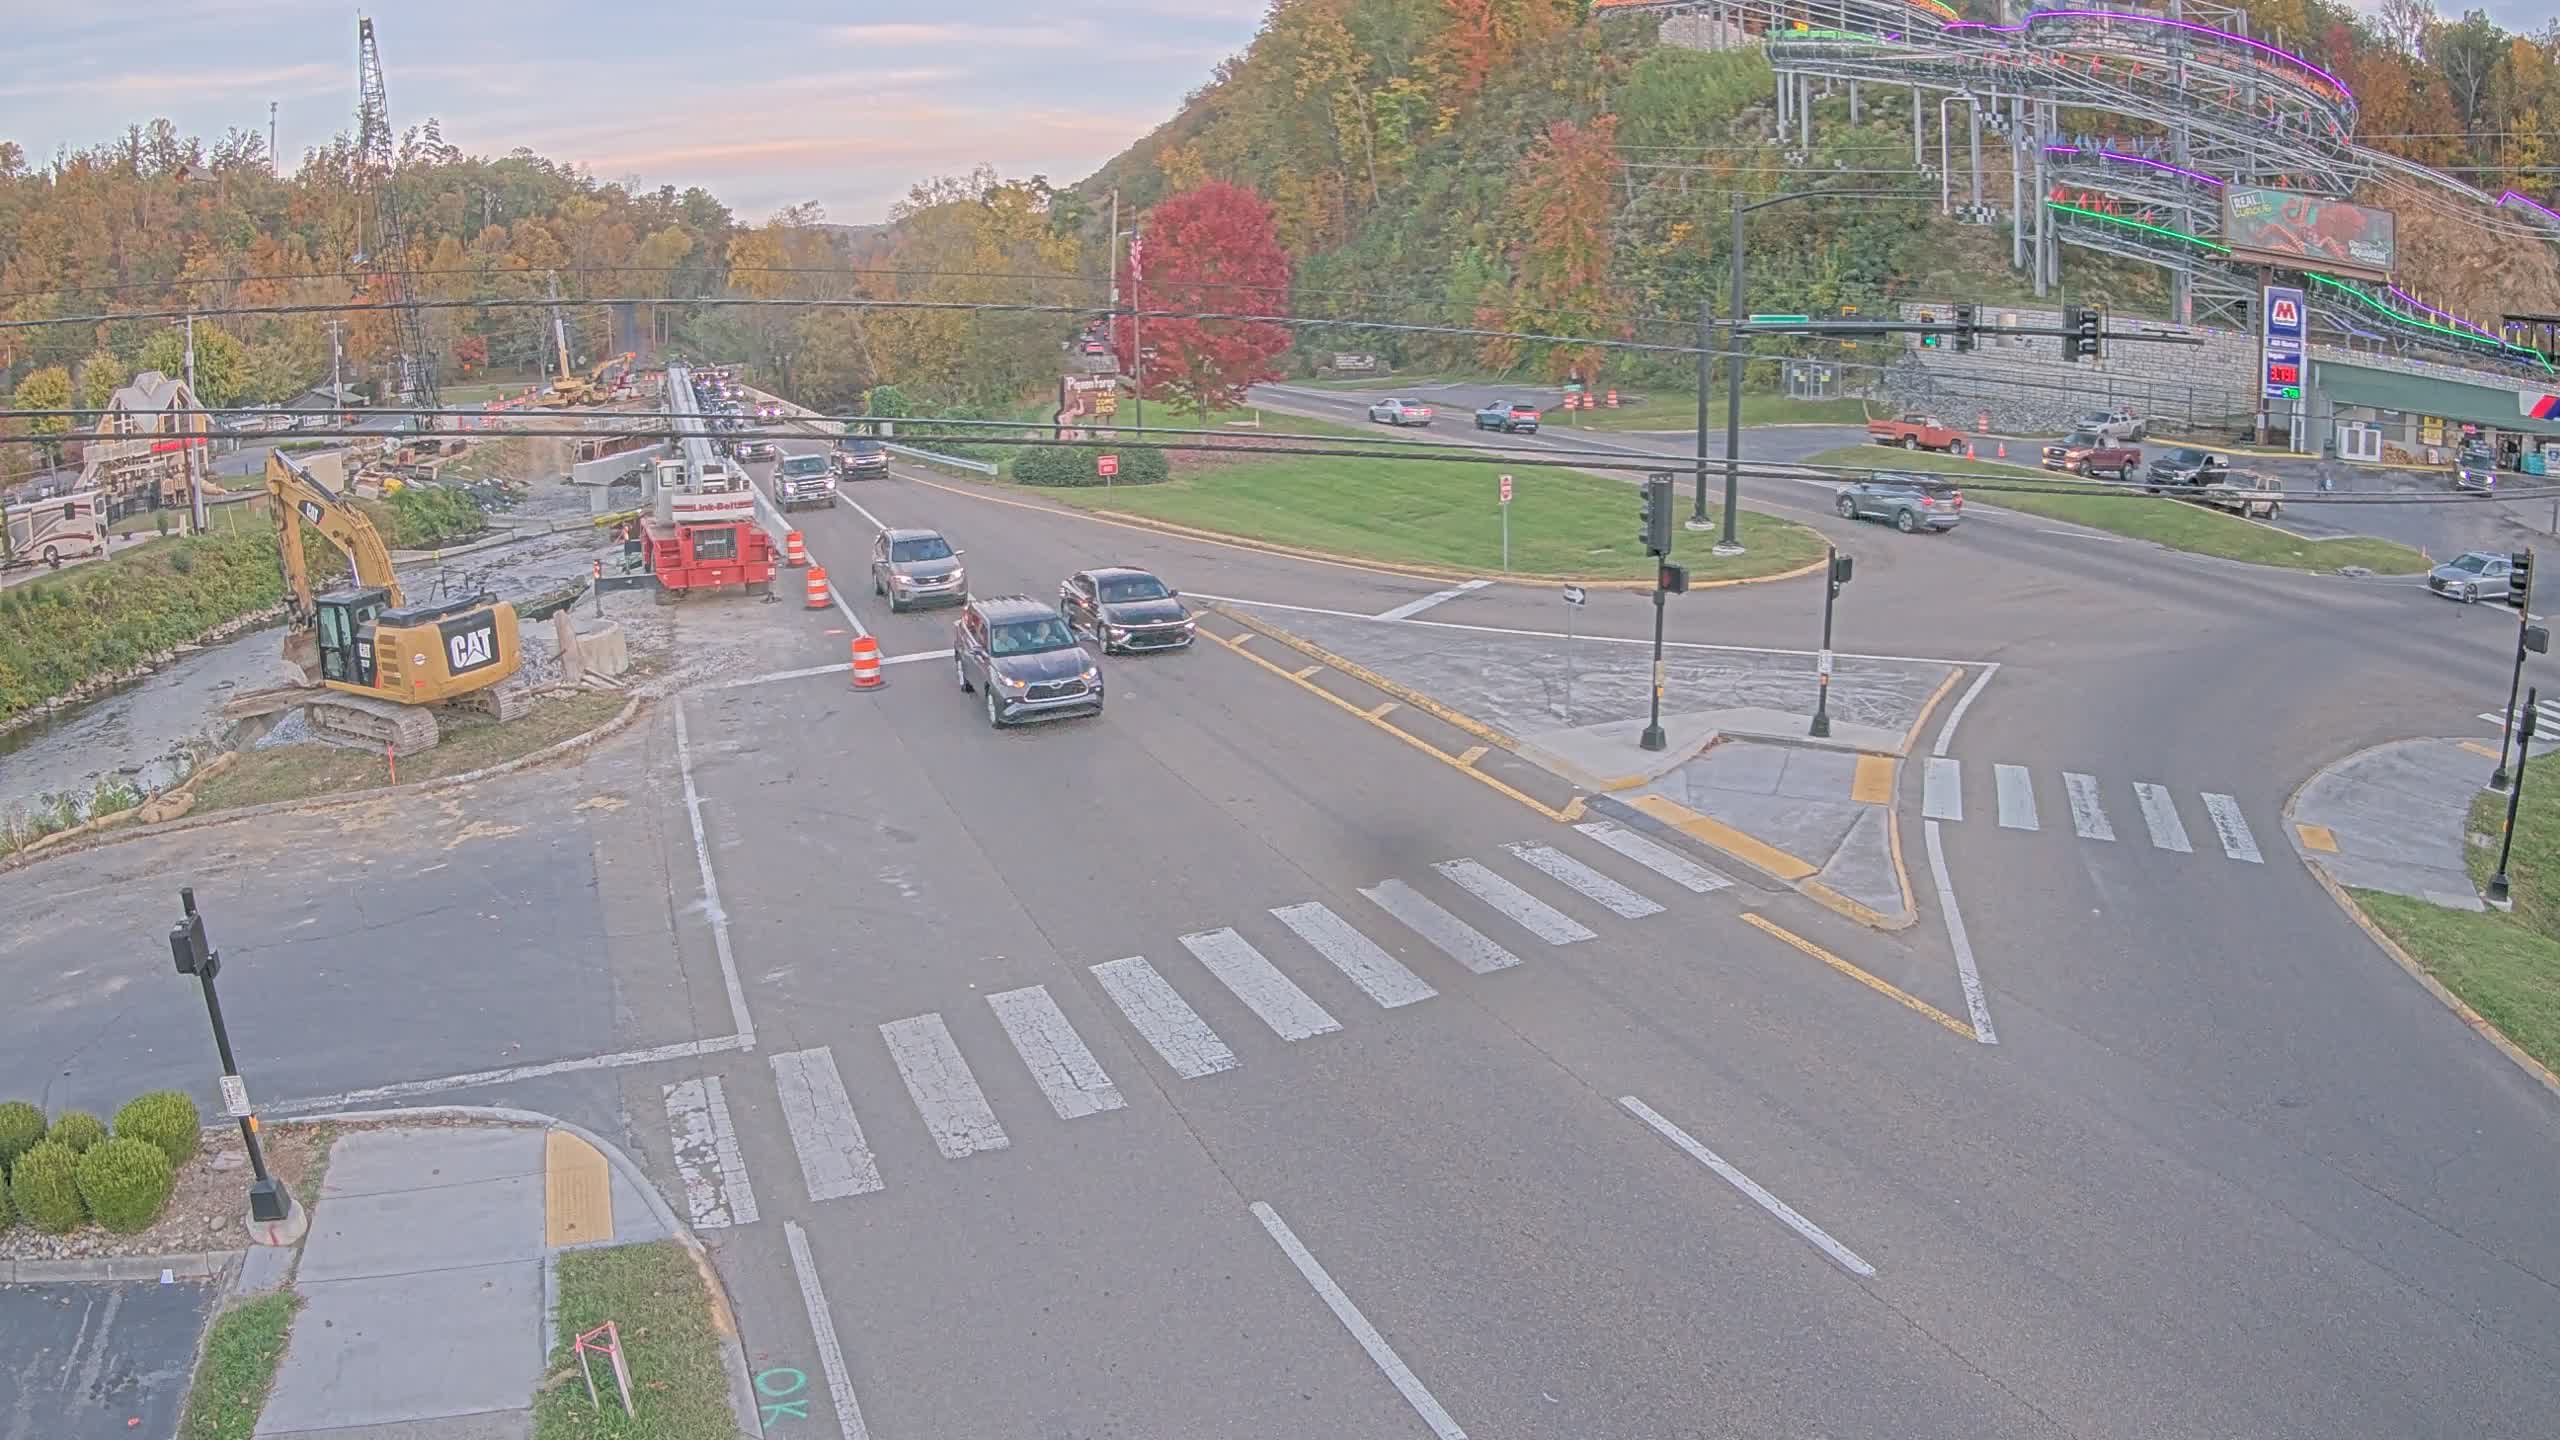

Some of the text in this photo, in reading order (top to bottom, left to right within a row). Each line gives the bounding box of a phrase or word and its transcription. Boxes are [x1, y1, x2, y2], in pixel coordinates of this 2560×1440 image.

[2233, 194, 2258, 208] REAL
[306, 502, 319, 522] CAT
[693, 501, 737, 511] Link-Belt
[451, 627, 492, 668] CAT
[755, 1367, 808, 1430] OK
